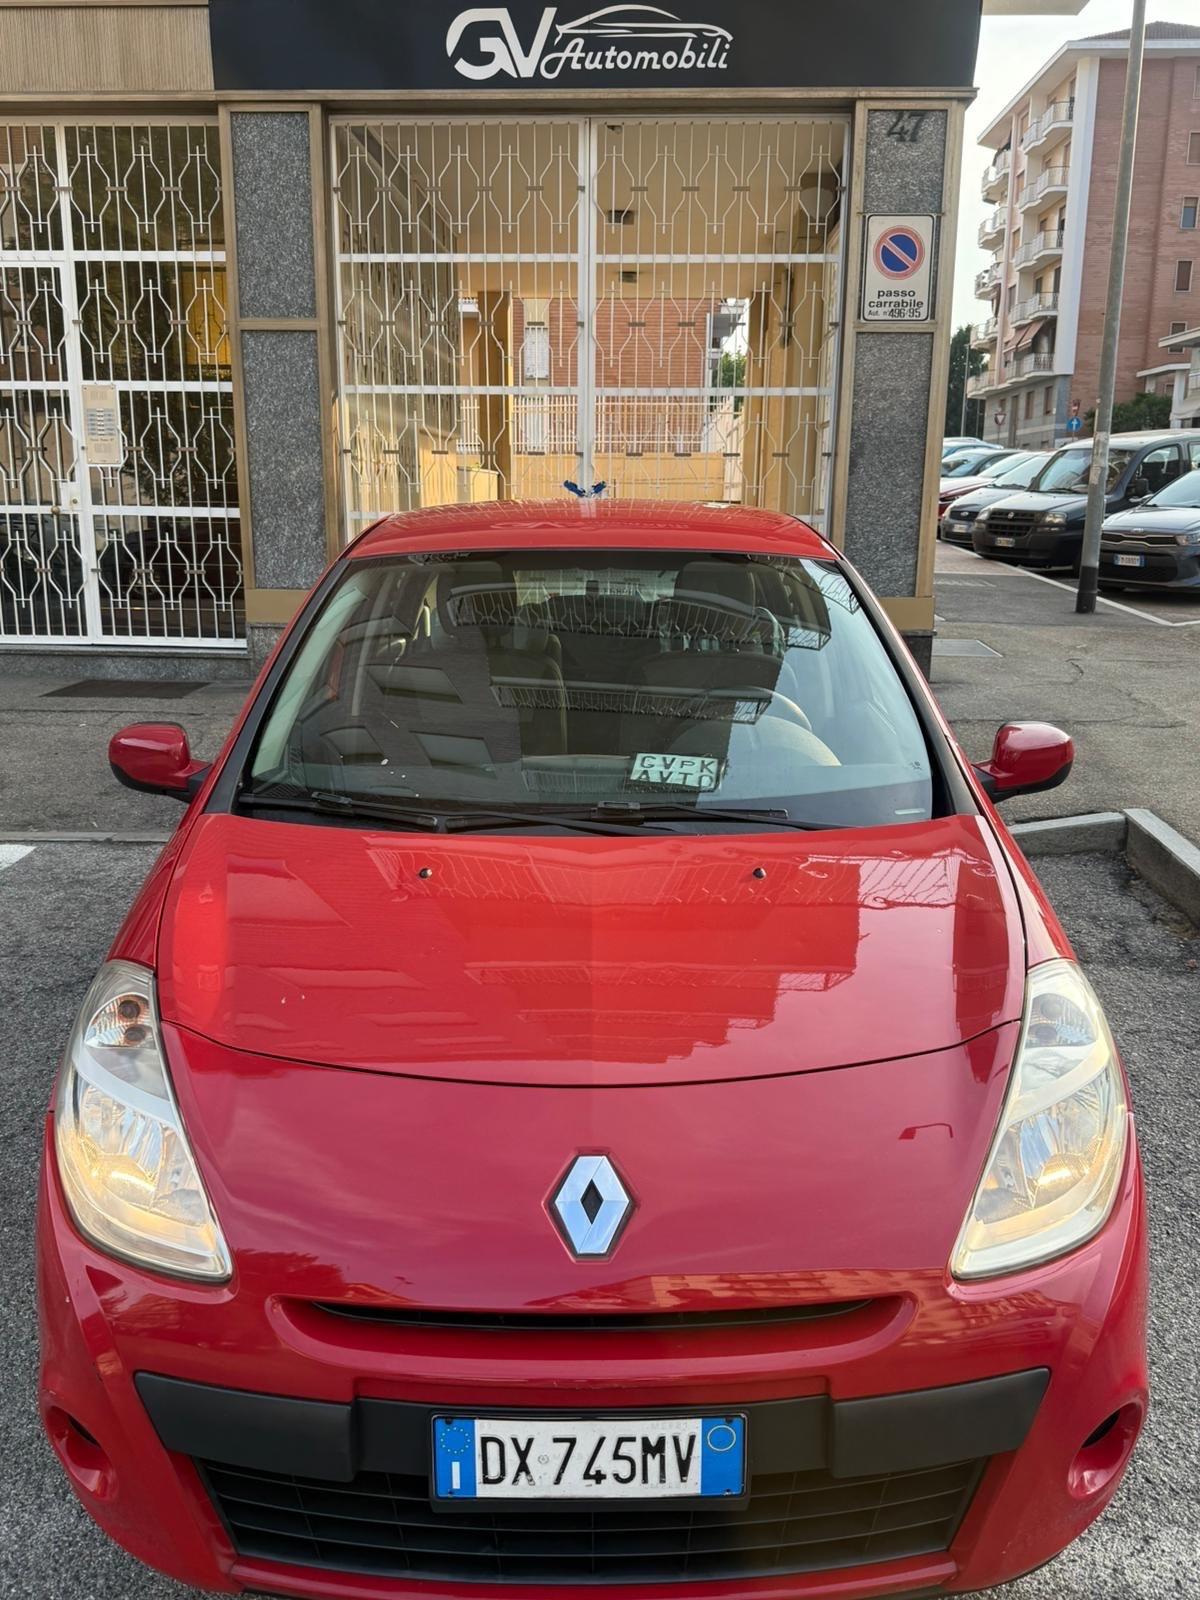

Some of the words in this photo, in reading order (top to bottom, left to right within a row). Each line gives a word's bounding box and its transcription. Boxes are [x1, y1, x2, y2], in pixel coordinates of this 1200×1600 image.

[446, 7, 558, 80] GV
[540, 37, 731, 79] Automobili
[886, 109, 926, 142] 47
[868, 299, 924, 308] carrabile
[877, 289, 916, 299] passo
[480, 1435, 536, 1486] DX
[552, 1434, 697, 1486] 745MV
